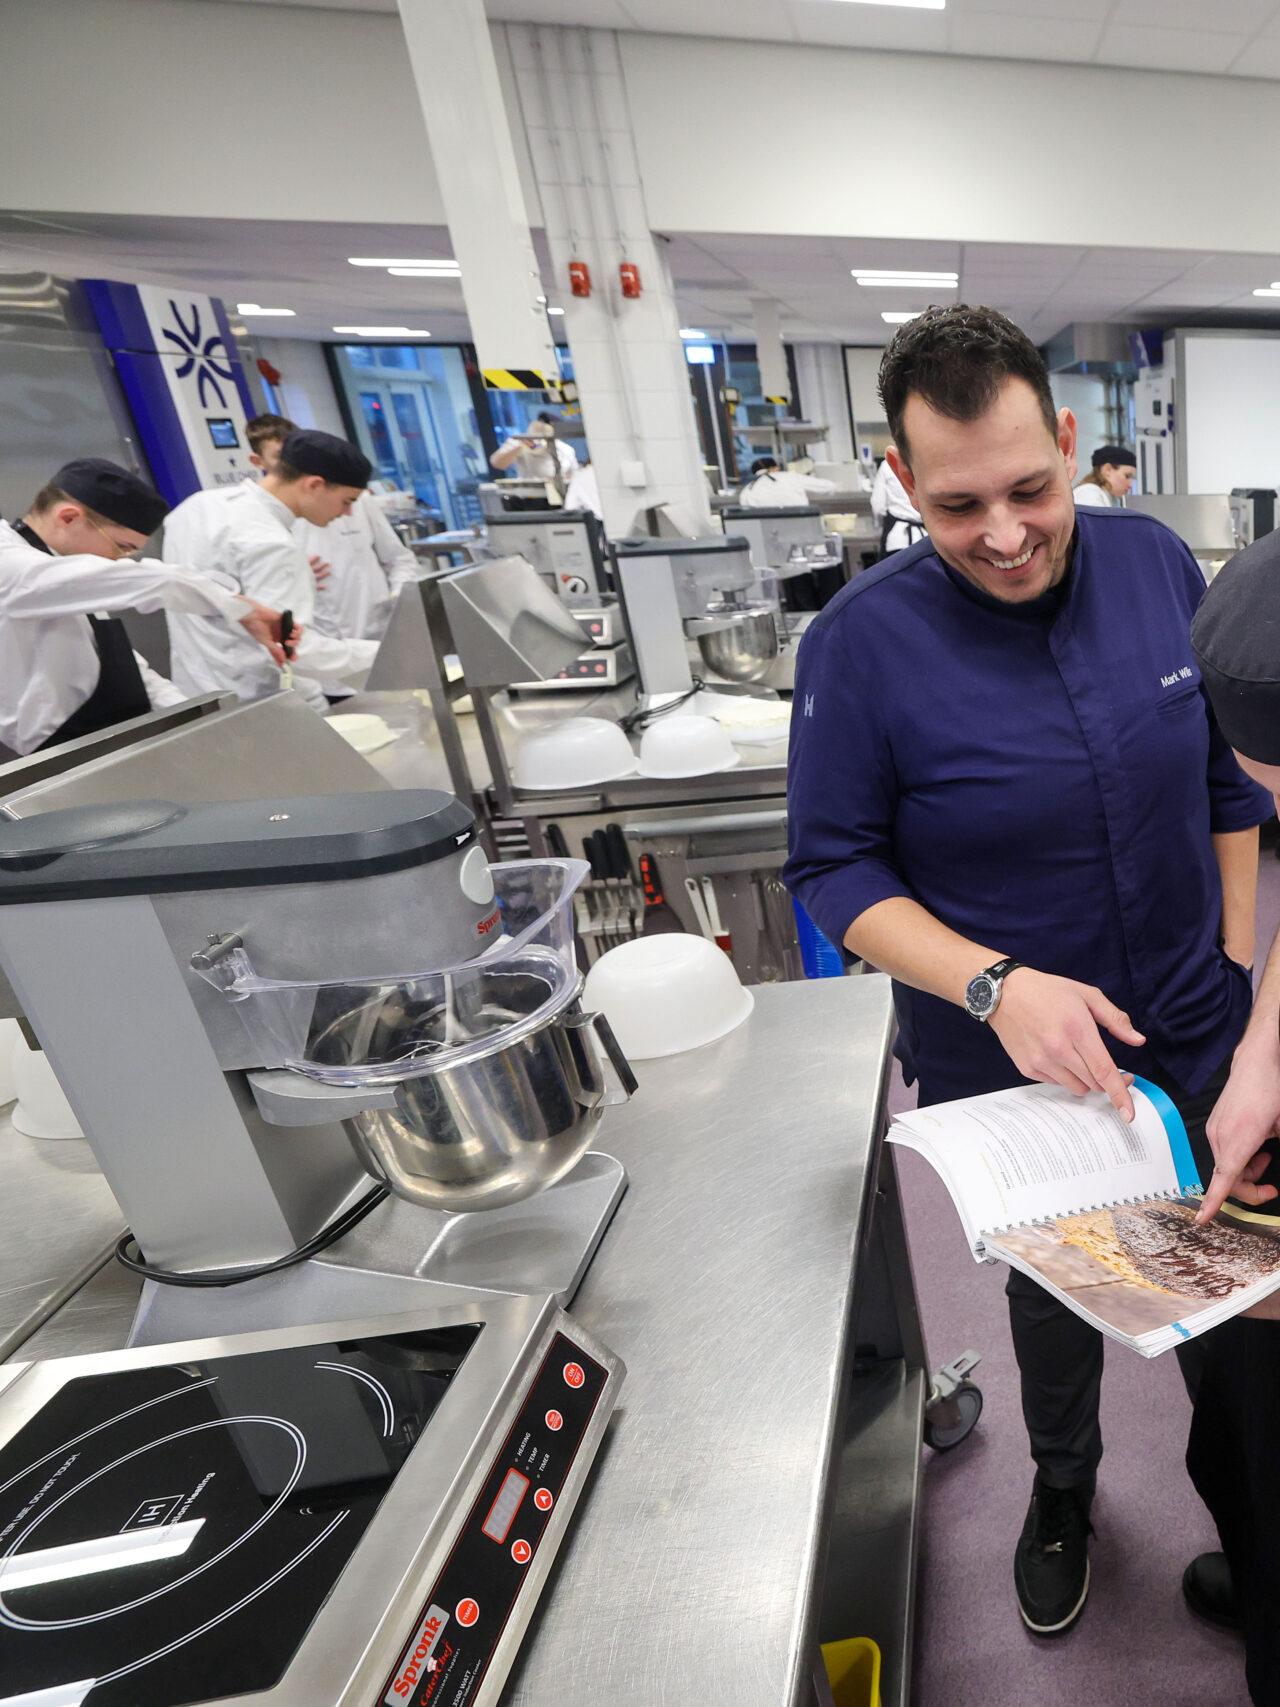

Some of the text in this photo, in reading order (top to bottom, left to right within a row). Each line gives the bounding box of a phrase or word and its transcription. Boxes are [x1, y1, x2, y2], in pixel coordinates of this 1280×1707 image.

[1160, 672, 1180, 688] Mark
[568, 1367, 576, 1377] ON
[517, 1432, 531, 1457] HEATING
[528, 1447, 538, 1464] TEMP
[539, 1453, 550, 1472] TIMER
[39, 1478, 57, 1493] NOT
[184, 1472, 216, 1505] Heating
[462, 1603, 474, 1621] TIMER
[393, 1616, 442, 1698] Spronk
[452, 1670, 472, 1707] 3500 WATT
